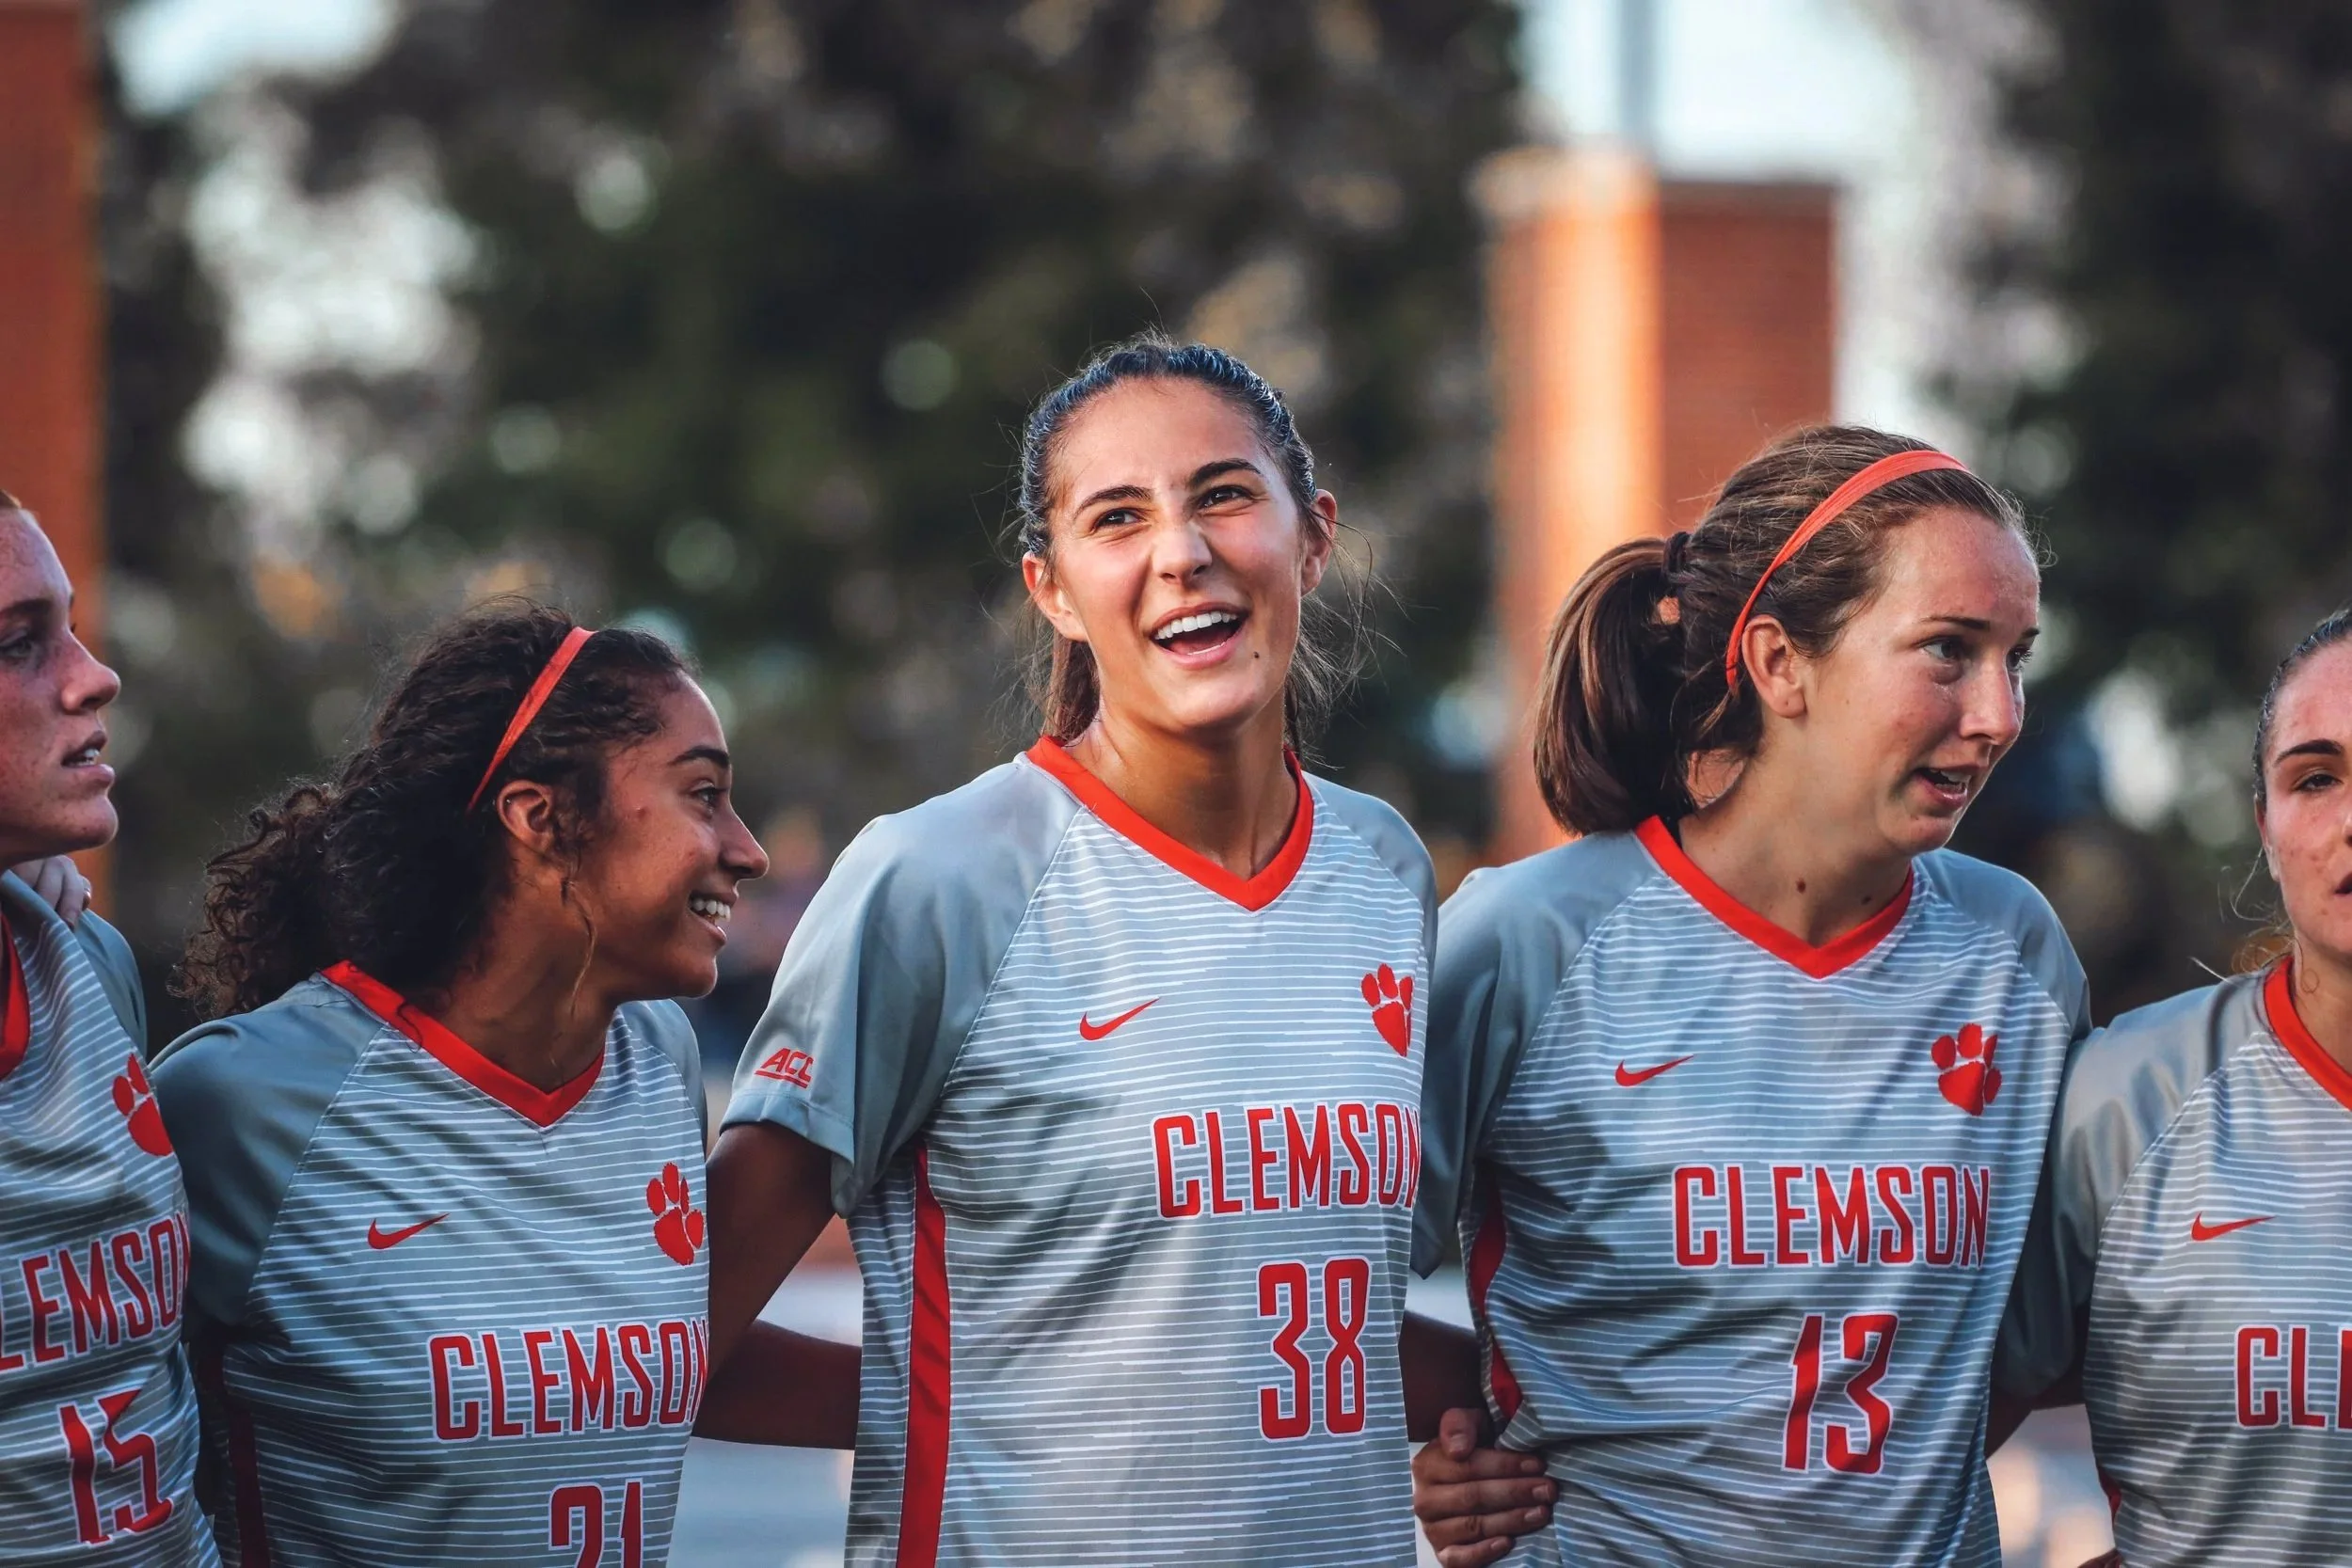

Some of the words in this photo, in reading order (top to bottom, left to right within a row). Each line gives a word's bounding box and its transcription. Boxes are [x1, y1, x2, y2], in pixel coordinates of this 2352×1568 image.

[760, 1047, 814, 1083] ACC
[1671, 1163, 1990, 1270] CLEMSON
[1258, 1257, 1371, 1440] 38
[1781, 1311, 1899, 1475] 13
[58, 1386, 173, 1547] 15
